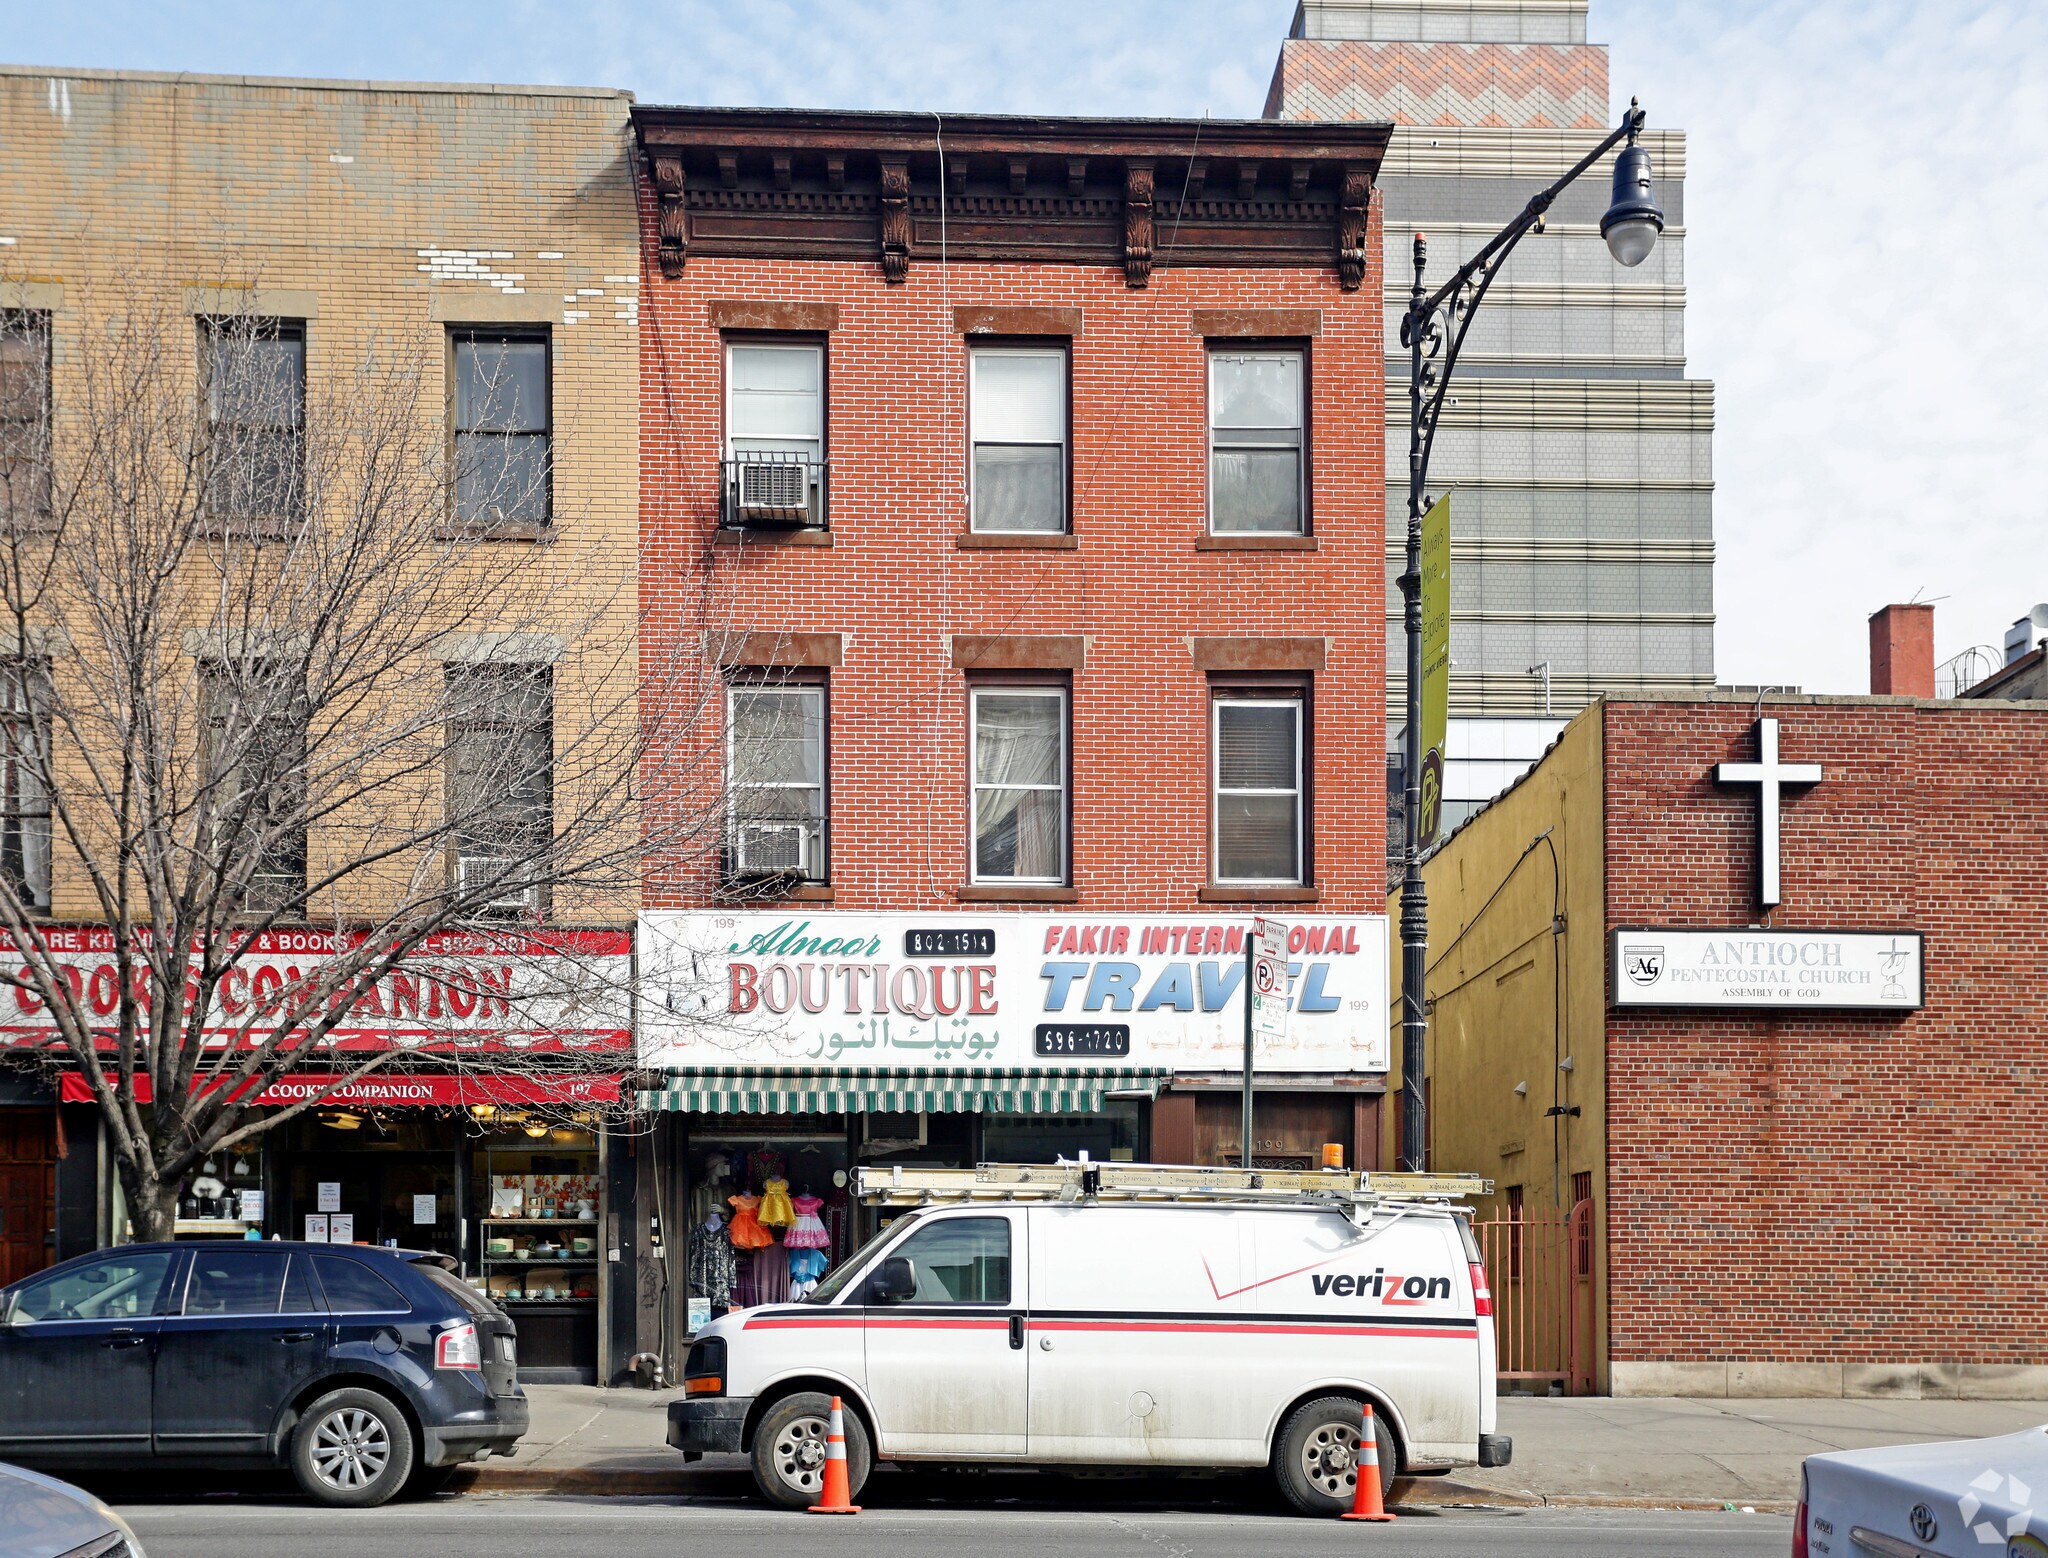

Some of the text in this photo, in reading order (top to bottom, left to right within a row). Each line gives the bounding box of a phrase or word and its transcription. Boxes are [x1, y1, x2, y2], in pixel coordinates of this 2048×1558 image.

[1423, 527, 1444, 557] Always
[1423, 563, 1438, 585] More
[1424, 595, 1431, 614] To
[714, 919, 735, 929] 199
[1254, 918, 1284, 938] NO PARKING
[95, 932, 176, 950] KITH
[258, 934, 271, 950] &
[278, 934, 349, 951] BOOKS
[728, 921, 881, 957] Alnoor
[1044, 925, 1360, 954] FAKIR INTERNONAL
[1261, 938, 1280, 950] ANYTIME
[1700, 941, 1842, 966] ANTIOCH
[1671, 968, 1871, 984] PENTECOSTAL CHURCH
[14, 963, 513, 1019] COOKS COMPANION
[727, 963, 999, 1020] BOUTIQUE
[1721, 987, 1820, 998] ASSEMBLY OF GOD
[1262, 1001, 1285, 1012] PARKING
[1349, 1001, 1369, 1010] 199
[804, 1017, 889, 1061] النور
[892, 1017, 999, 1060] بوتيك
[1045, 1030, 1123, 1051] 596-1720
[333, 1085, 433, 1099] COMPANION
[570, 1083, 590, 1096] 197
[1256, 1140, 1283, 1152] 199
[1312, 1267, 1450, 1305] verizon
